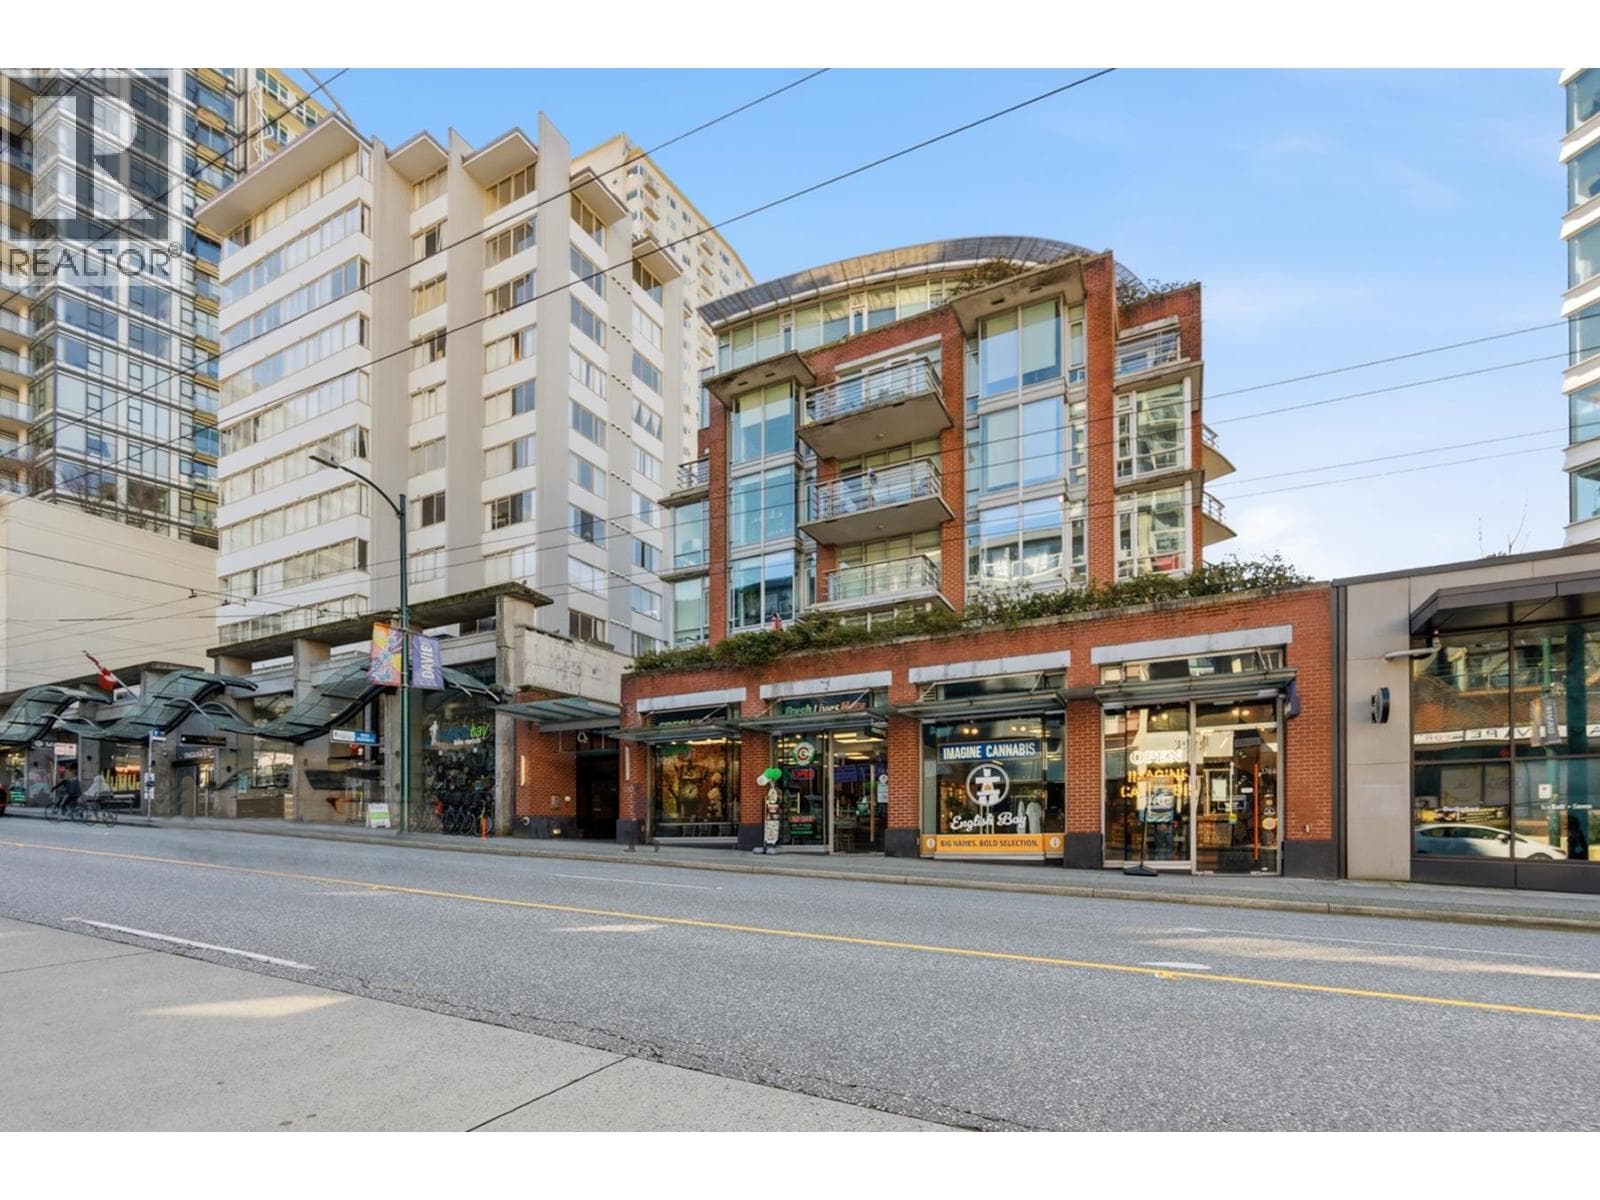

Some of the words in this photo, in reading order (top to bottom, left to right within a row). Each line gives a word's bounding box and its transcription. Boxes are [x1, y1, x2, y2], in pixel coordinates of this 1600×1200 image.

[420, 642, 435, 680] DAVIE
[943, 745, 982, 760] IMAGINE
[985, 742, 1036, 758] CANNABIS
[1129, 750, 1184, 765] OPEN
[950, 813, 994, 832] English
[997, 811, 1027, 828] Bay
[940, 839, 952, 848] BIG
[979, 838, 998, 848] BOLD
